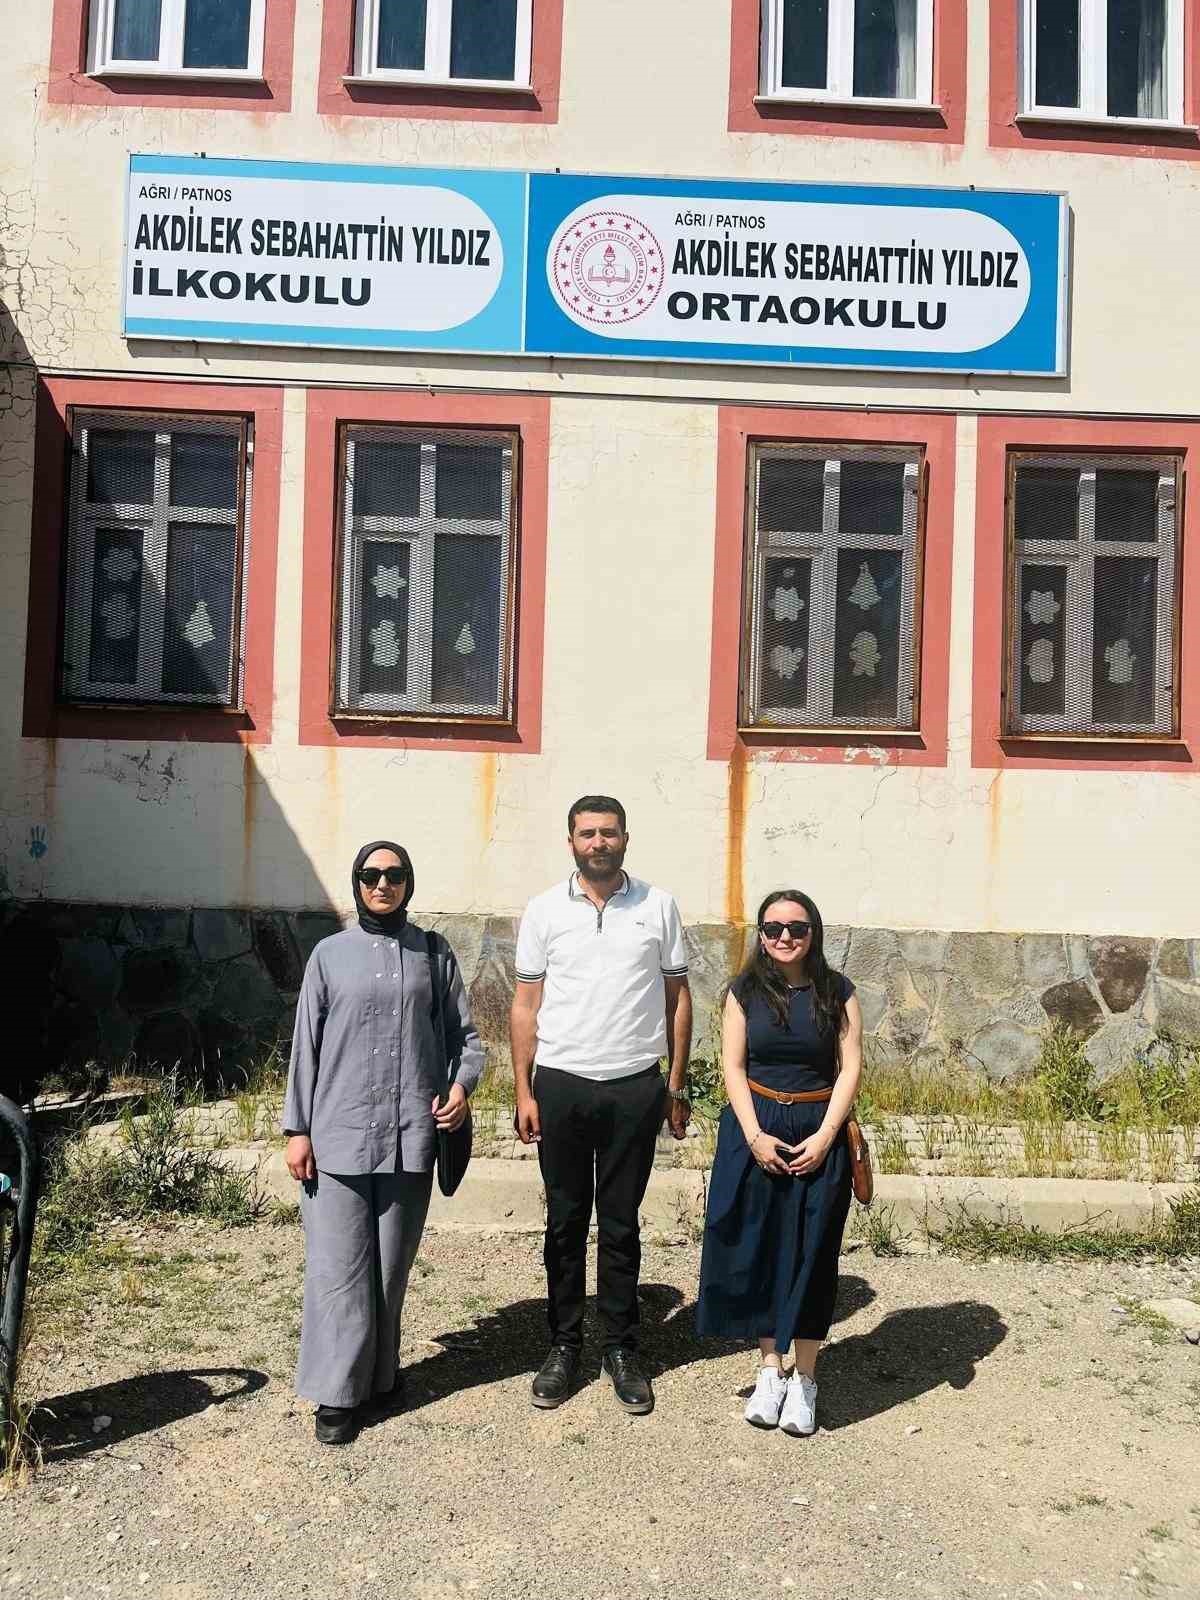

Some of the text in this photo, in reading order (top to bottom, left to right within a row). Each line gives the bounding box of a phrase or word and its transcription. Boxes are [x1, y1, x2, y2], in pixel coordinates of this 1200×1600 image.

[138, 184, 232, 202] AĞRI / PATNOS
[134, 206, 491, 267] AKDİLEK SEBAHATTİN YILDIZ
[674, 211, 766, 230] AĞRI / PATNOS
[671, 231, 1019, 289] AKDİLEK SEBAHATTİN YILDIZ
[132, 260, 372, 307] İLKOKULU
[667, 291, 947, 330] ORTAOKULU
